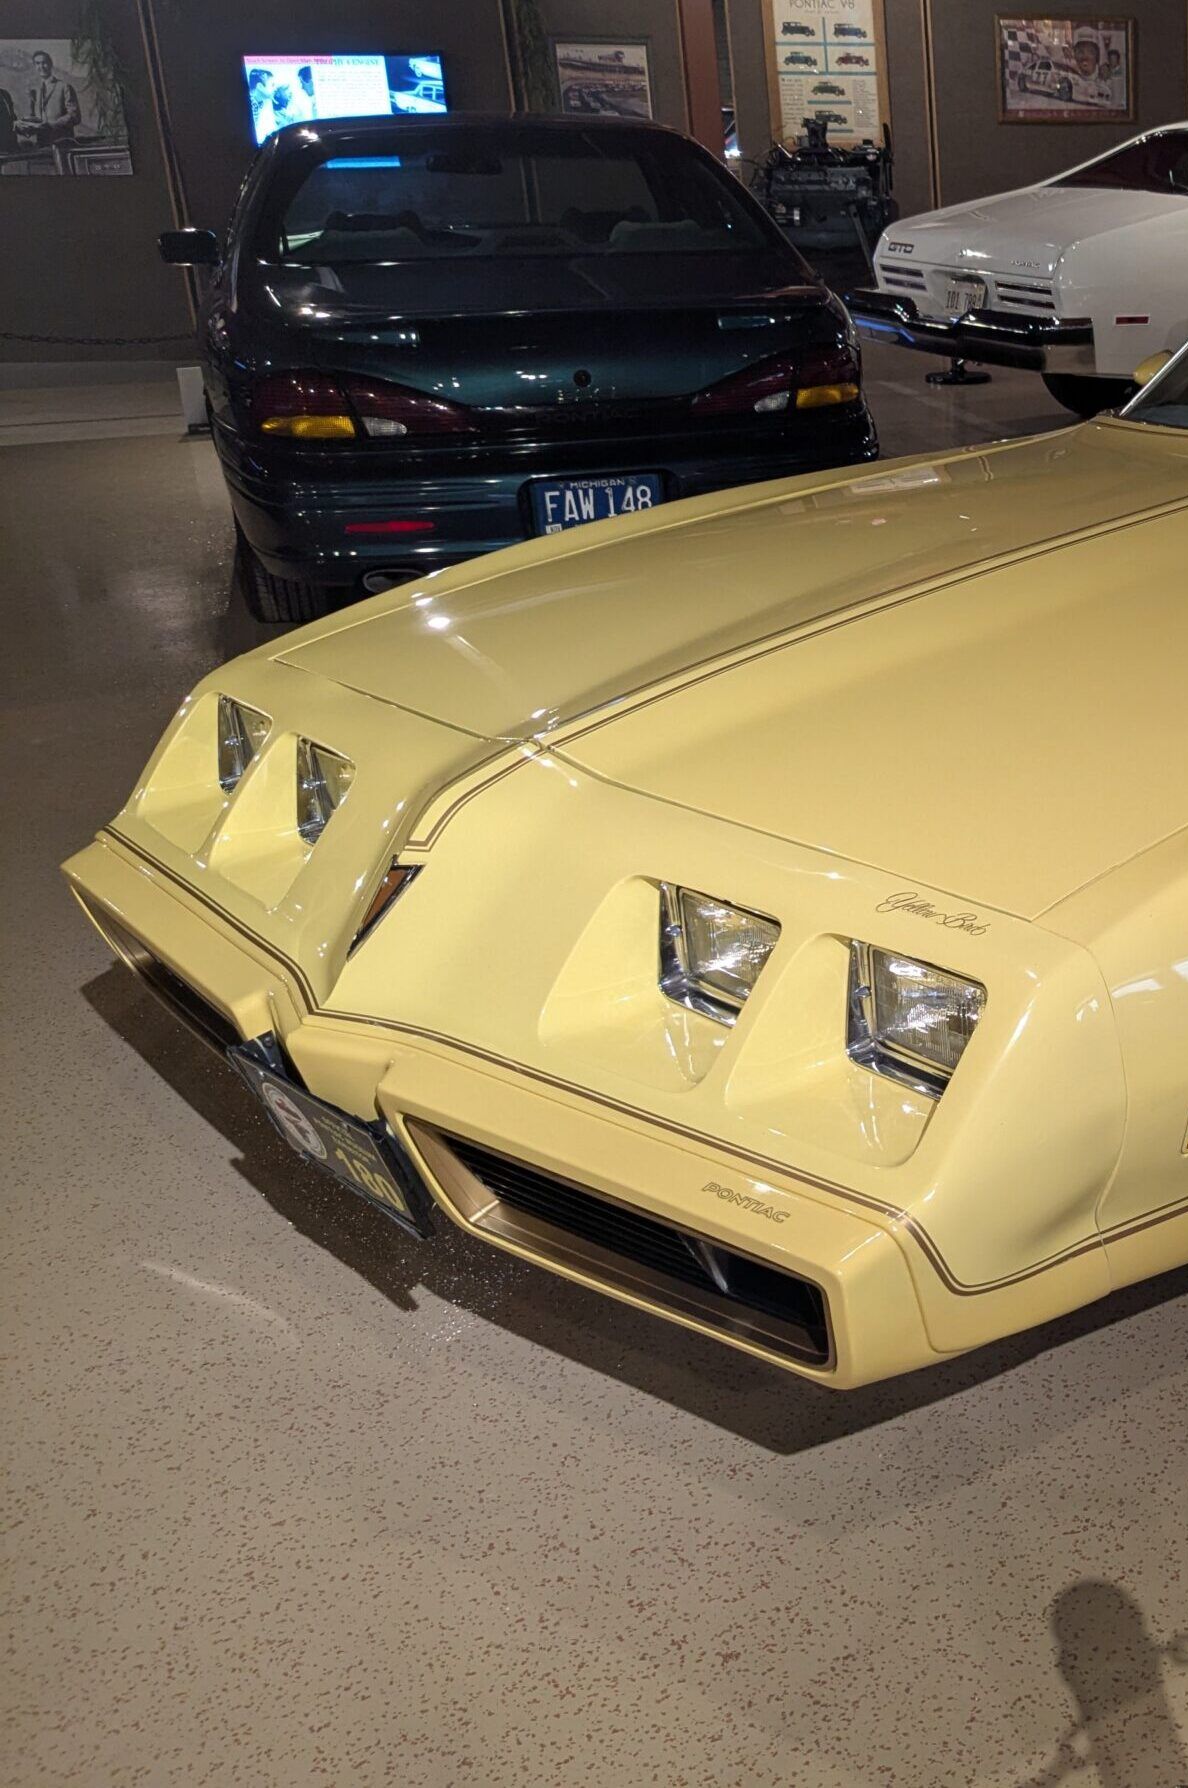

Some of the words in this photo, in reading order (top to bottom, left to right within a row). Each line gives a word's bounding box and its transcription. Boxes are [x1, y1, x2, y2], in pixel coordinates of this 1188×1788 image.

[789, 0, 836, 9] PONTIAC
[888, 242, 914, 253] GTO
[570, 479, 625, 488] MICHIGAN
[544, 488, 595, 522] FAW
[605, 485, 652, 518] 148
[701, 1182, 791, 1223] PONTIAC
